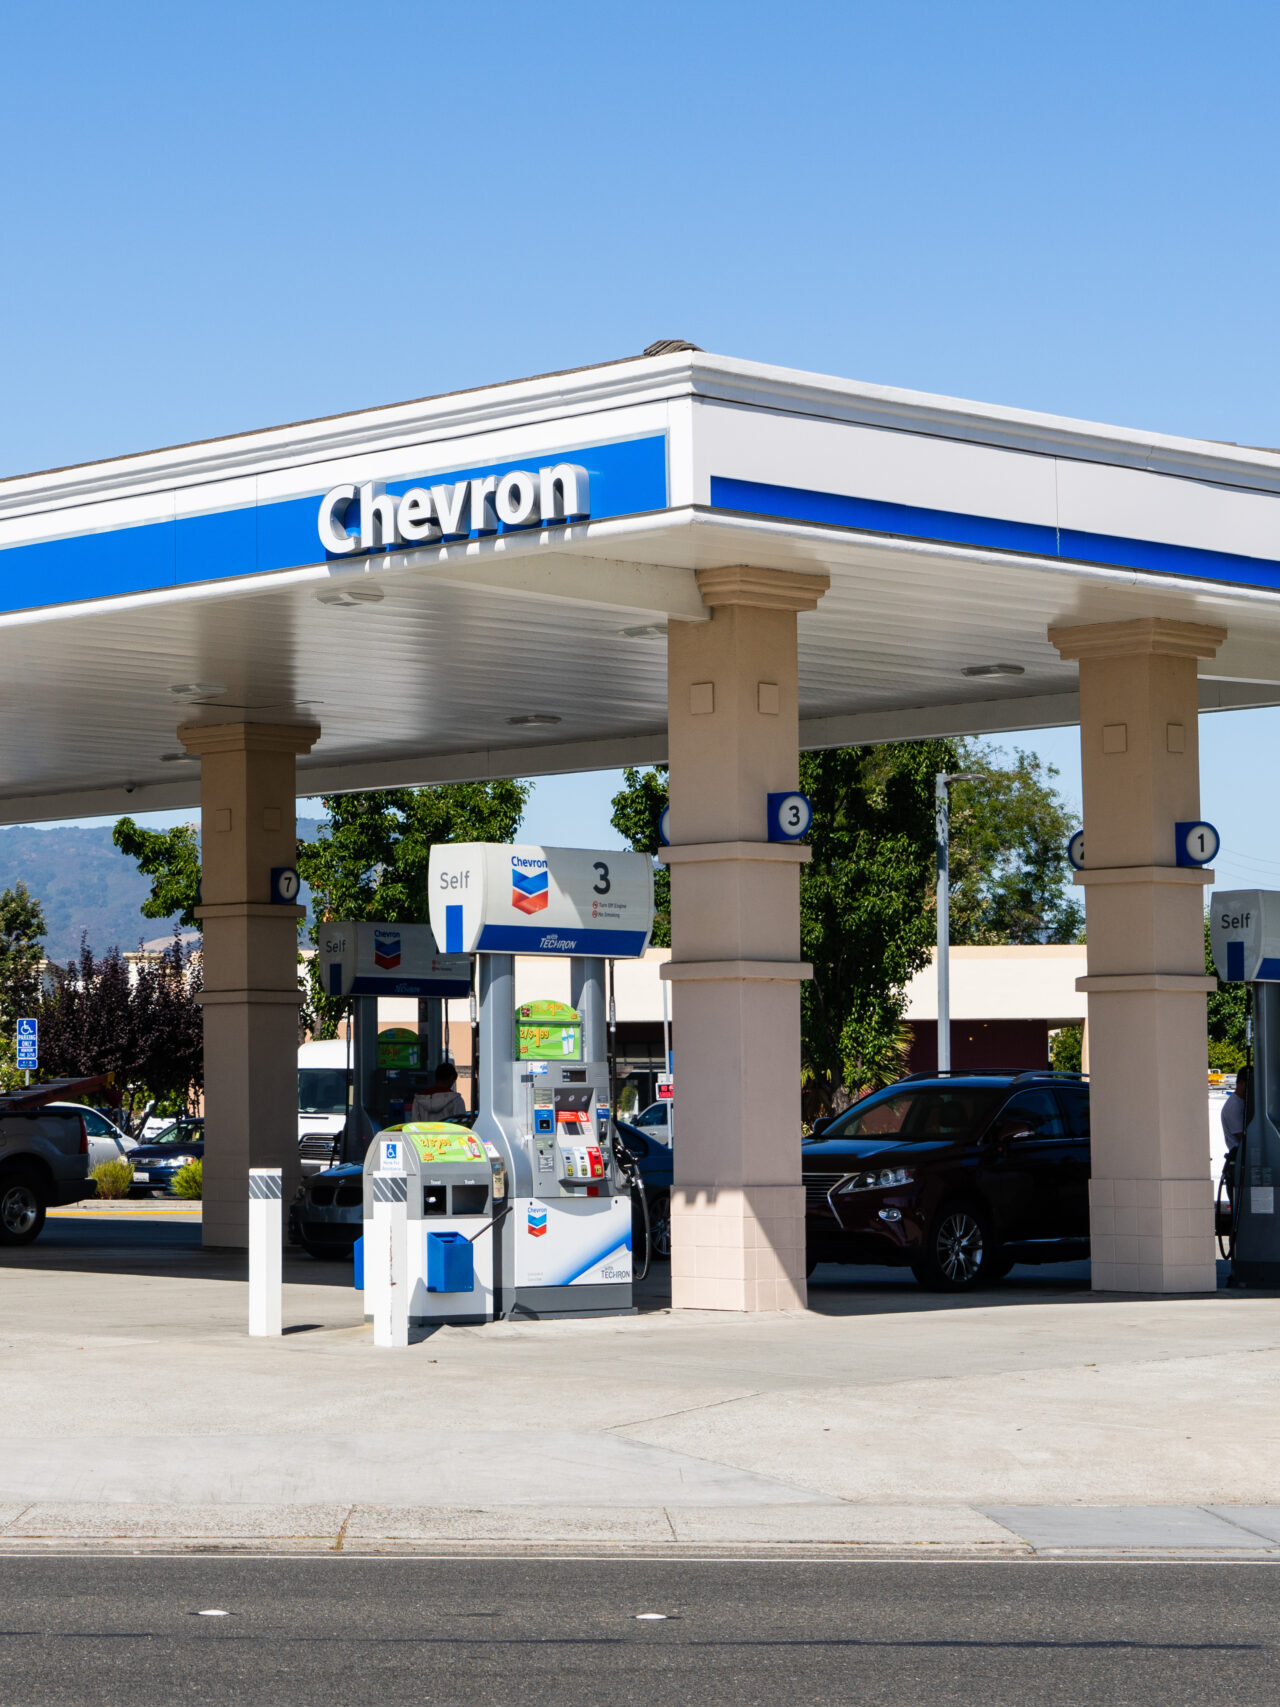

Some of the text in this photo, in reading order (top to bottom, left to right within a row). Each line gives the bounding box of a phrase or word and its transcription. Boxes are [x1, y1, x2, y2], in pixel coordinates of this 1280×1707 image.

[317, 462, 590, 554] Chevron
[788, 805, 800, 827] 3
[1197, 833, 1205, 853] 1
[511, 856, 548, 869] Chevron
[284, 876, 292, 893] 7
[440, 870, 470, 890] Self
[592, 861, 611, 895] 3
[1221, 912, 1250, 929] Self
[374, 929, 401, 938] Chevron
[325, 939, 347, 953] Self
[539, 937, 577, 951] TECHRON
[601, 1270, 630, 1280] TECHRON
